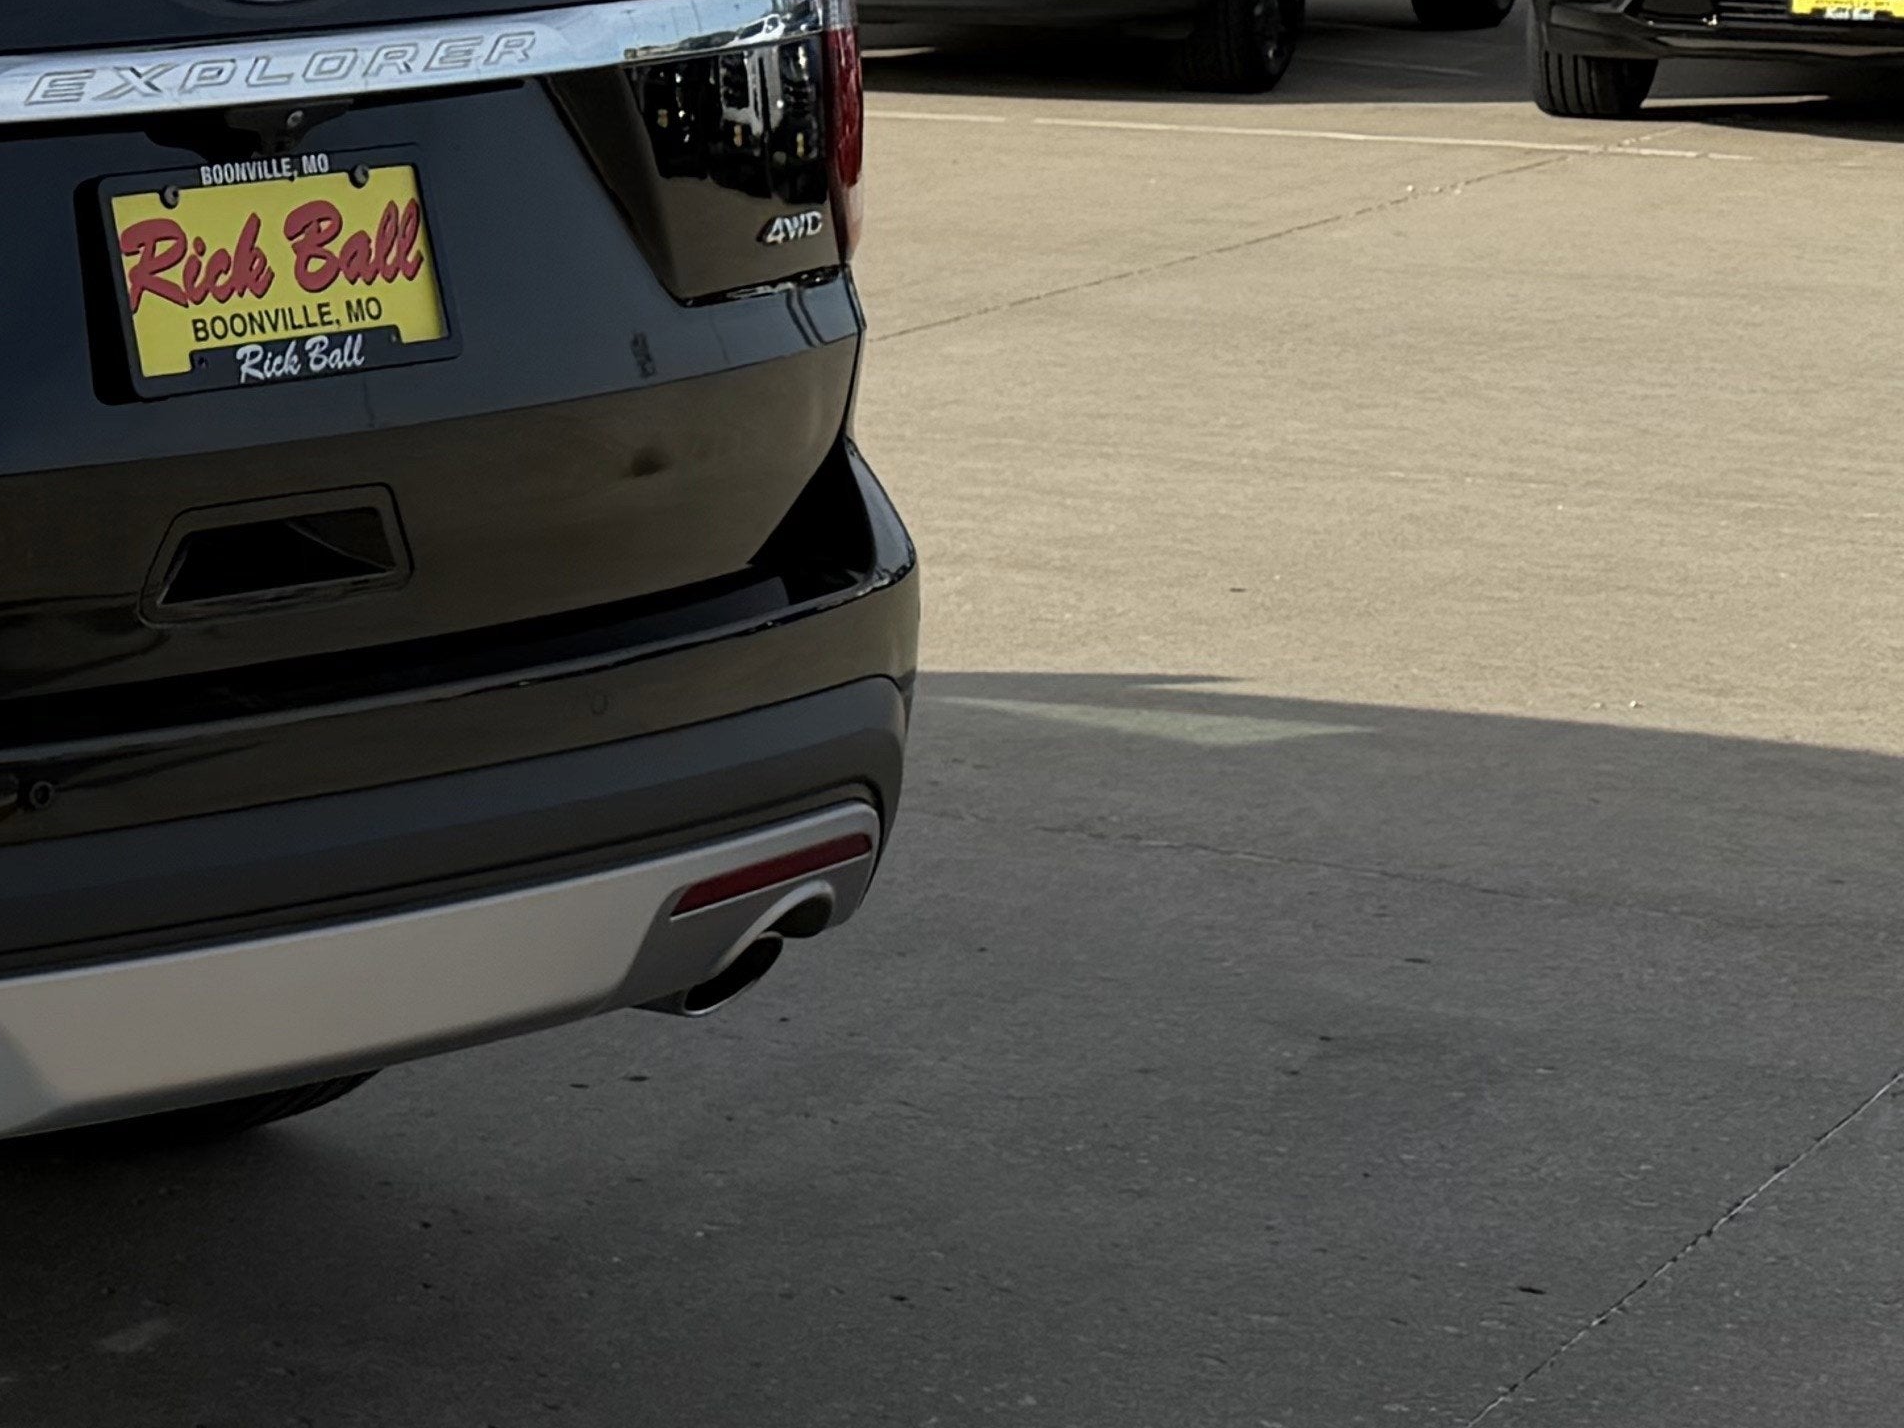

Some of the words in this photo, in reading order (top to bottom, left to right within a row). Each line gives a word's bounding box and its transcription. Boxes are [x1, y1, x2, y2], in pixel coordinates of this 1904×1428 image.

[25, 30, 536, 106] EXPLORER
[200, 156, 300, 186] BOONVILLE,
[302, 152, 330, 174] MO
[765, 211, 823, 244] 4WD
[121, 213, 274, 314] Rick
[283, 198, 424, 293] Ball
[192, 301, 342, 343] BOONVILLE,
[346, 296, 383, 322] MO
[236, 345, 301, 383] Rick
[303, 335, 366, 372] Ball
